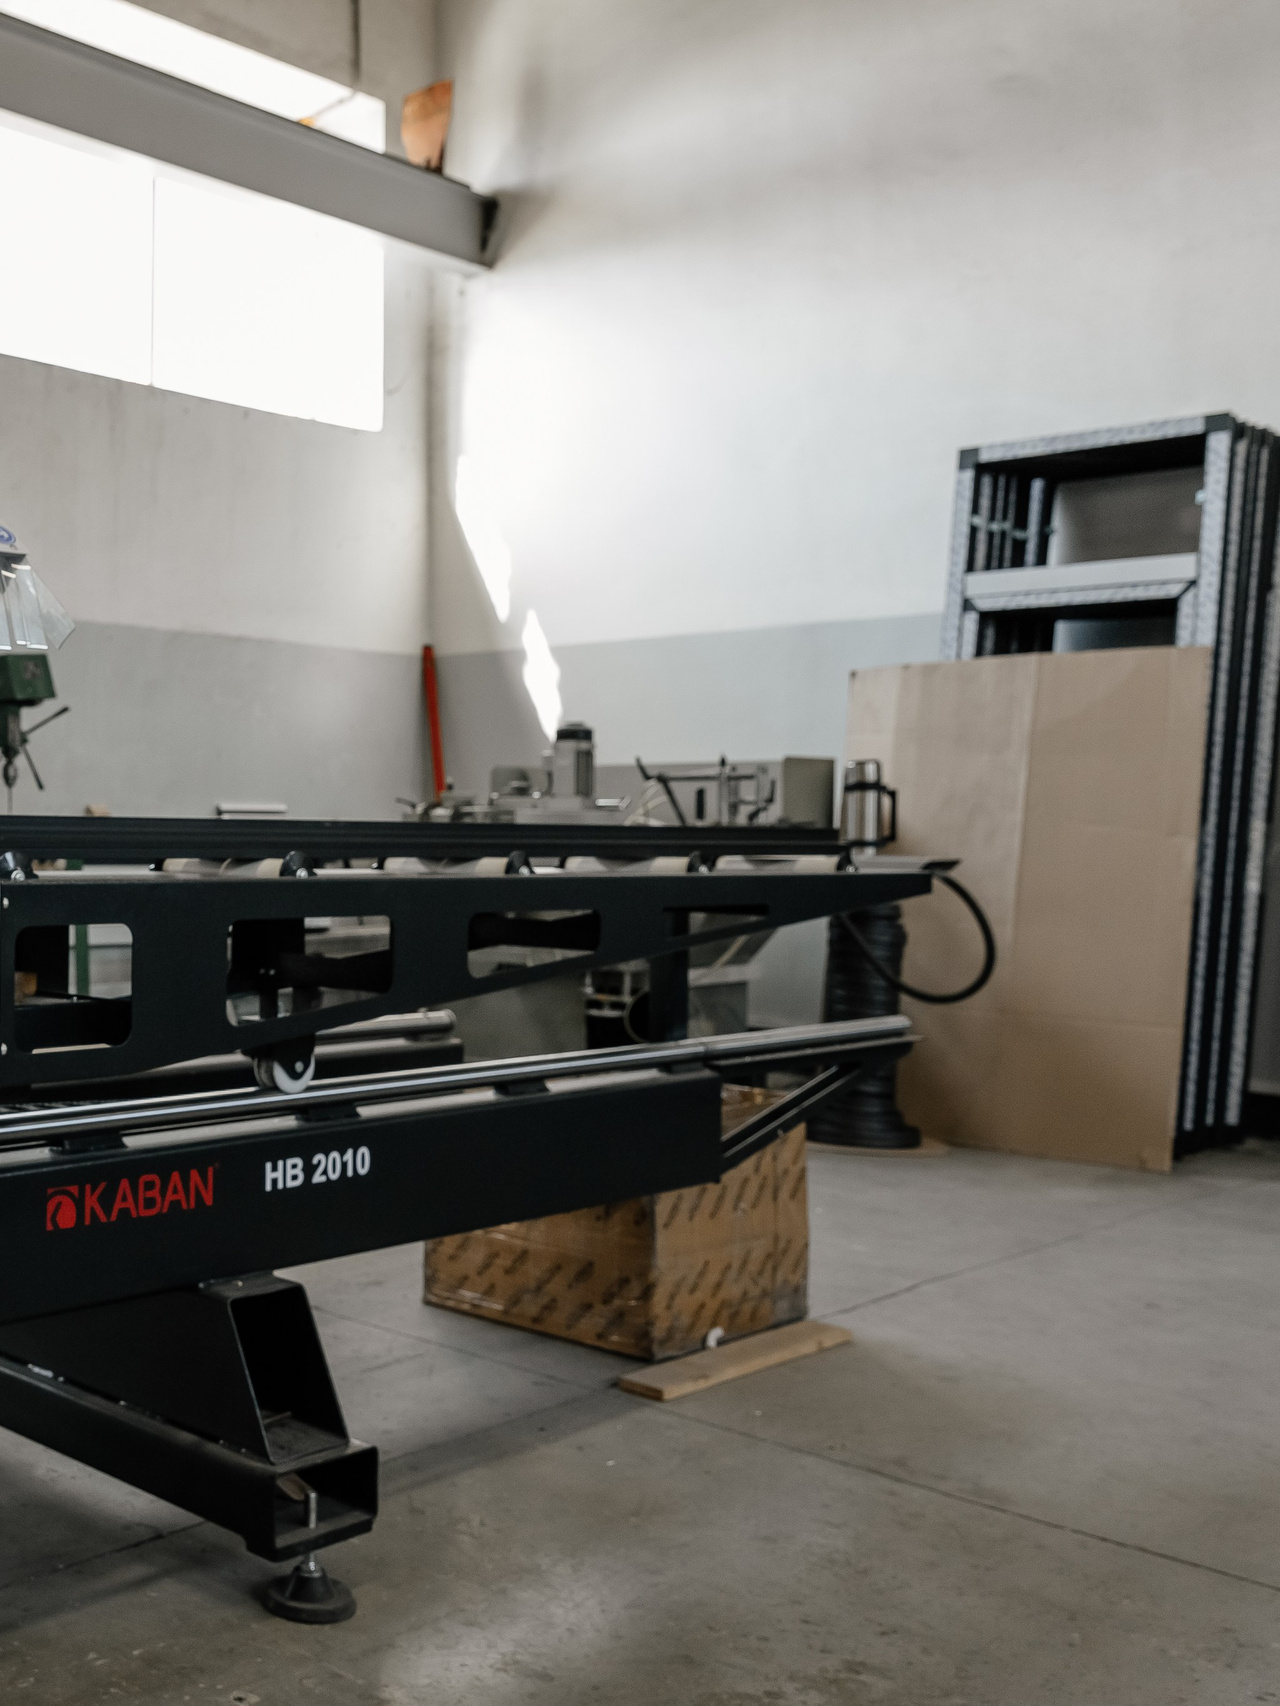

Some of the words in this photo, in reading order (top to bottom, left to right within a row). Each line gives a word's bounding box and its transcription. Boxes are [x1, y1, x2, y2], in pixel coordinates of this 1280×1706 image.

[265, 1157, 305, 1192] HB
[311, 1145, 371, 1184] 2010
[84, 1166, 214, 1226] KABAN
